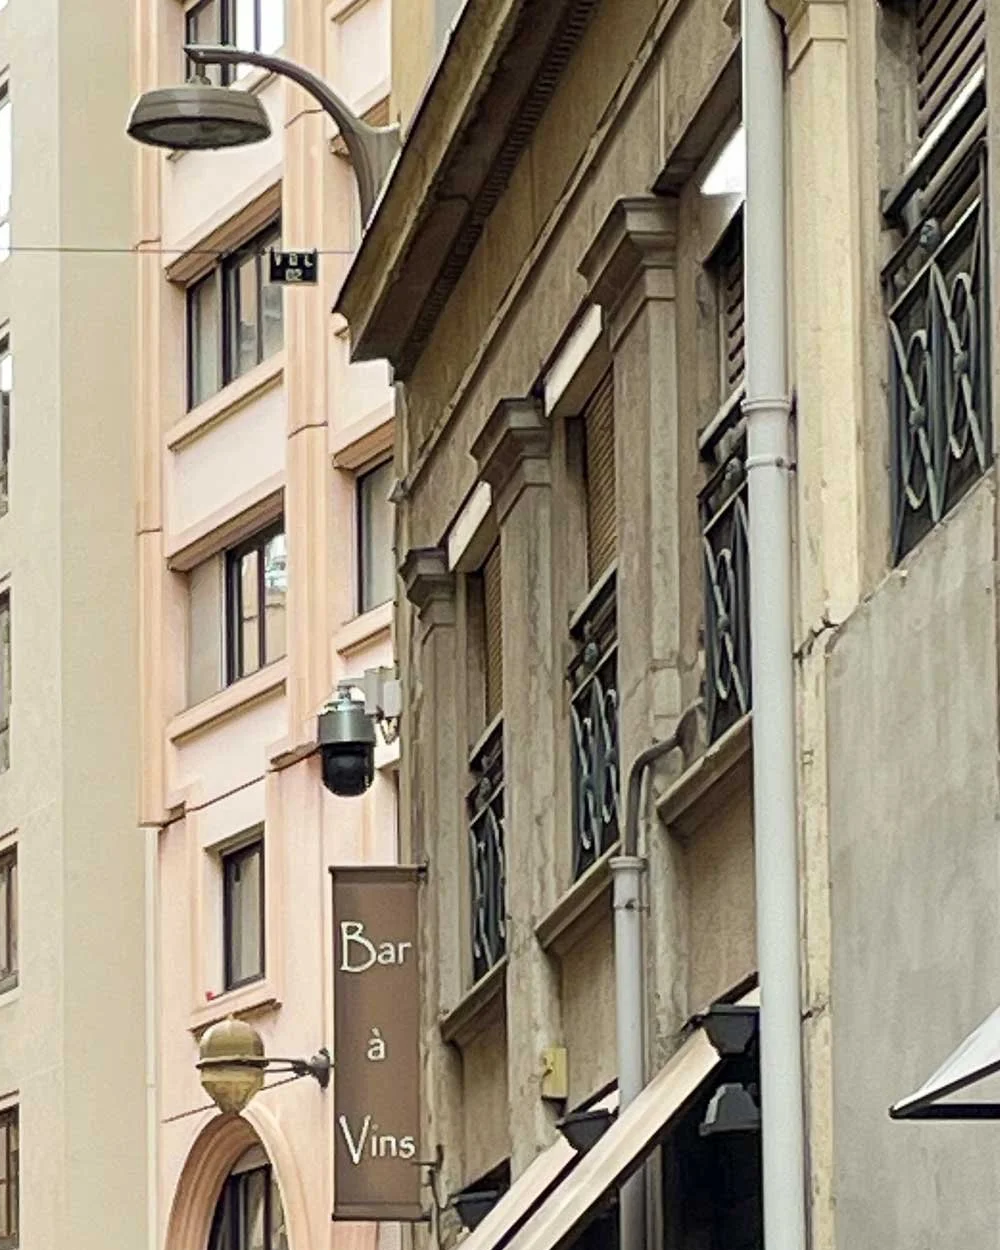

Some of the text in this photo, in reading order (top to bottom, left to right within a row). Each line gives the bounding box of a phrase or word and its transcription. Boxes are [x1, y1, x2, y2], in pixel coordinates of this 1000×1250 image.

[339, 920, 412, 972] Bar
[366, 1025, 387, 1061] à
[338, 1113, 416, 1165] Vins
